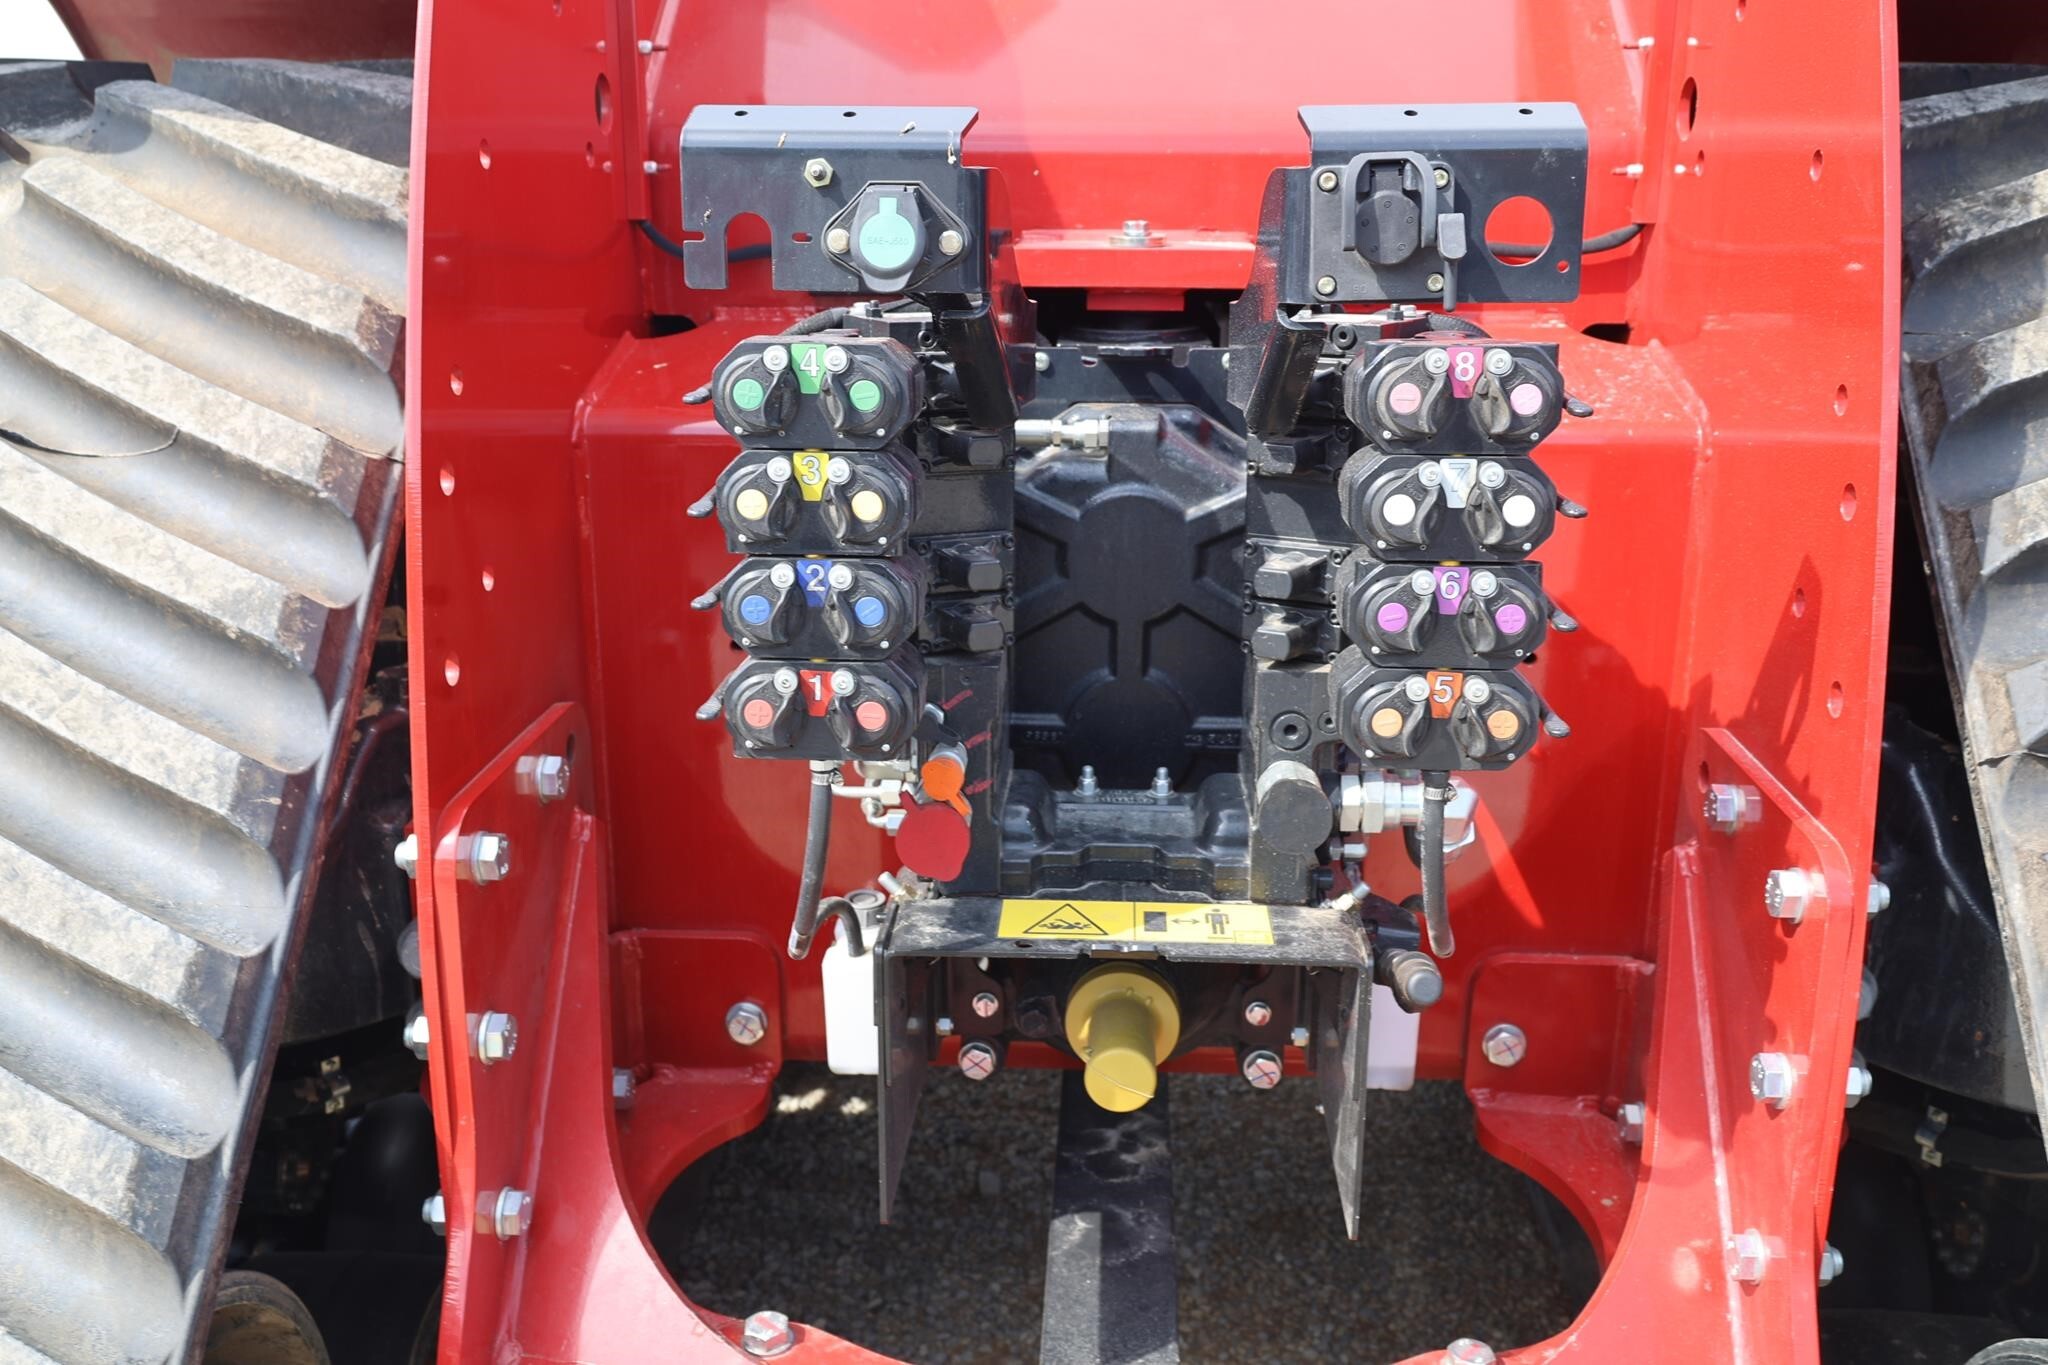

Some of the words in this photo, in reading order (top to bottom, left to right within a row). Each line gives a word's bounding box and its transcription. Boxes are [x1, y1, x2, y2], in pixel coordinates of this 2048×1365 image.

[799, 347, 819, 378] 4
[1455, 351, 1476, 383] 8
[801, 456, 821, 486] 3
[1448, 462, 1470, 492] 7
[806, 564, 826, 592] 2
[1440, 571, 1460, 600] 6
[809, 675, 822, 701] 1
[1432, 676, 1453, 703] 5
